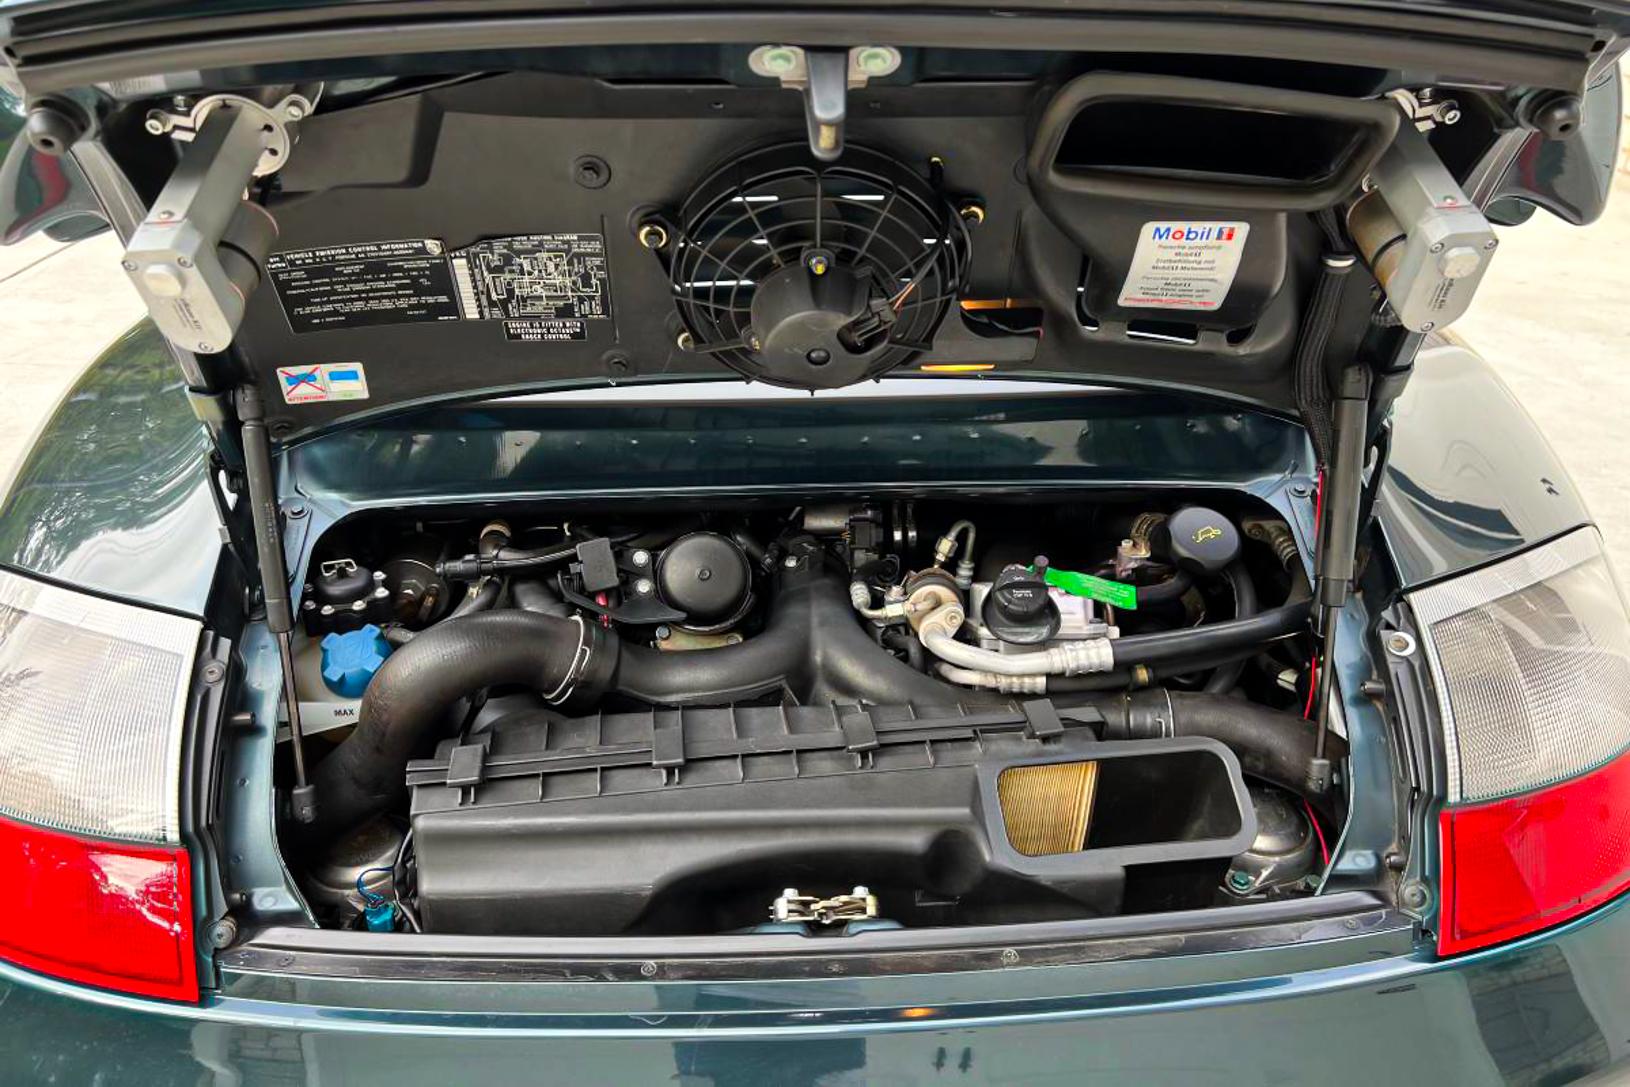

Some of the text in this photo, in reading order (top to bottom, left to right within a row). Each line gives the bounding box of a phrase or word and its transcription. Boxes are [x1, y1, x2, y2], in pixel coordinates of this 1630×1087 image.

[1152, 226, 1212, 241] Mobil
[348, 245, 378, 253] CONTROL
[380, 241, 424, 250] INFORMATION
[333, 708, 355, 717] MAX
